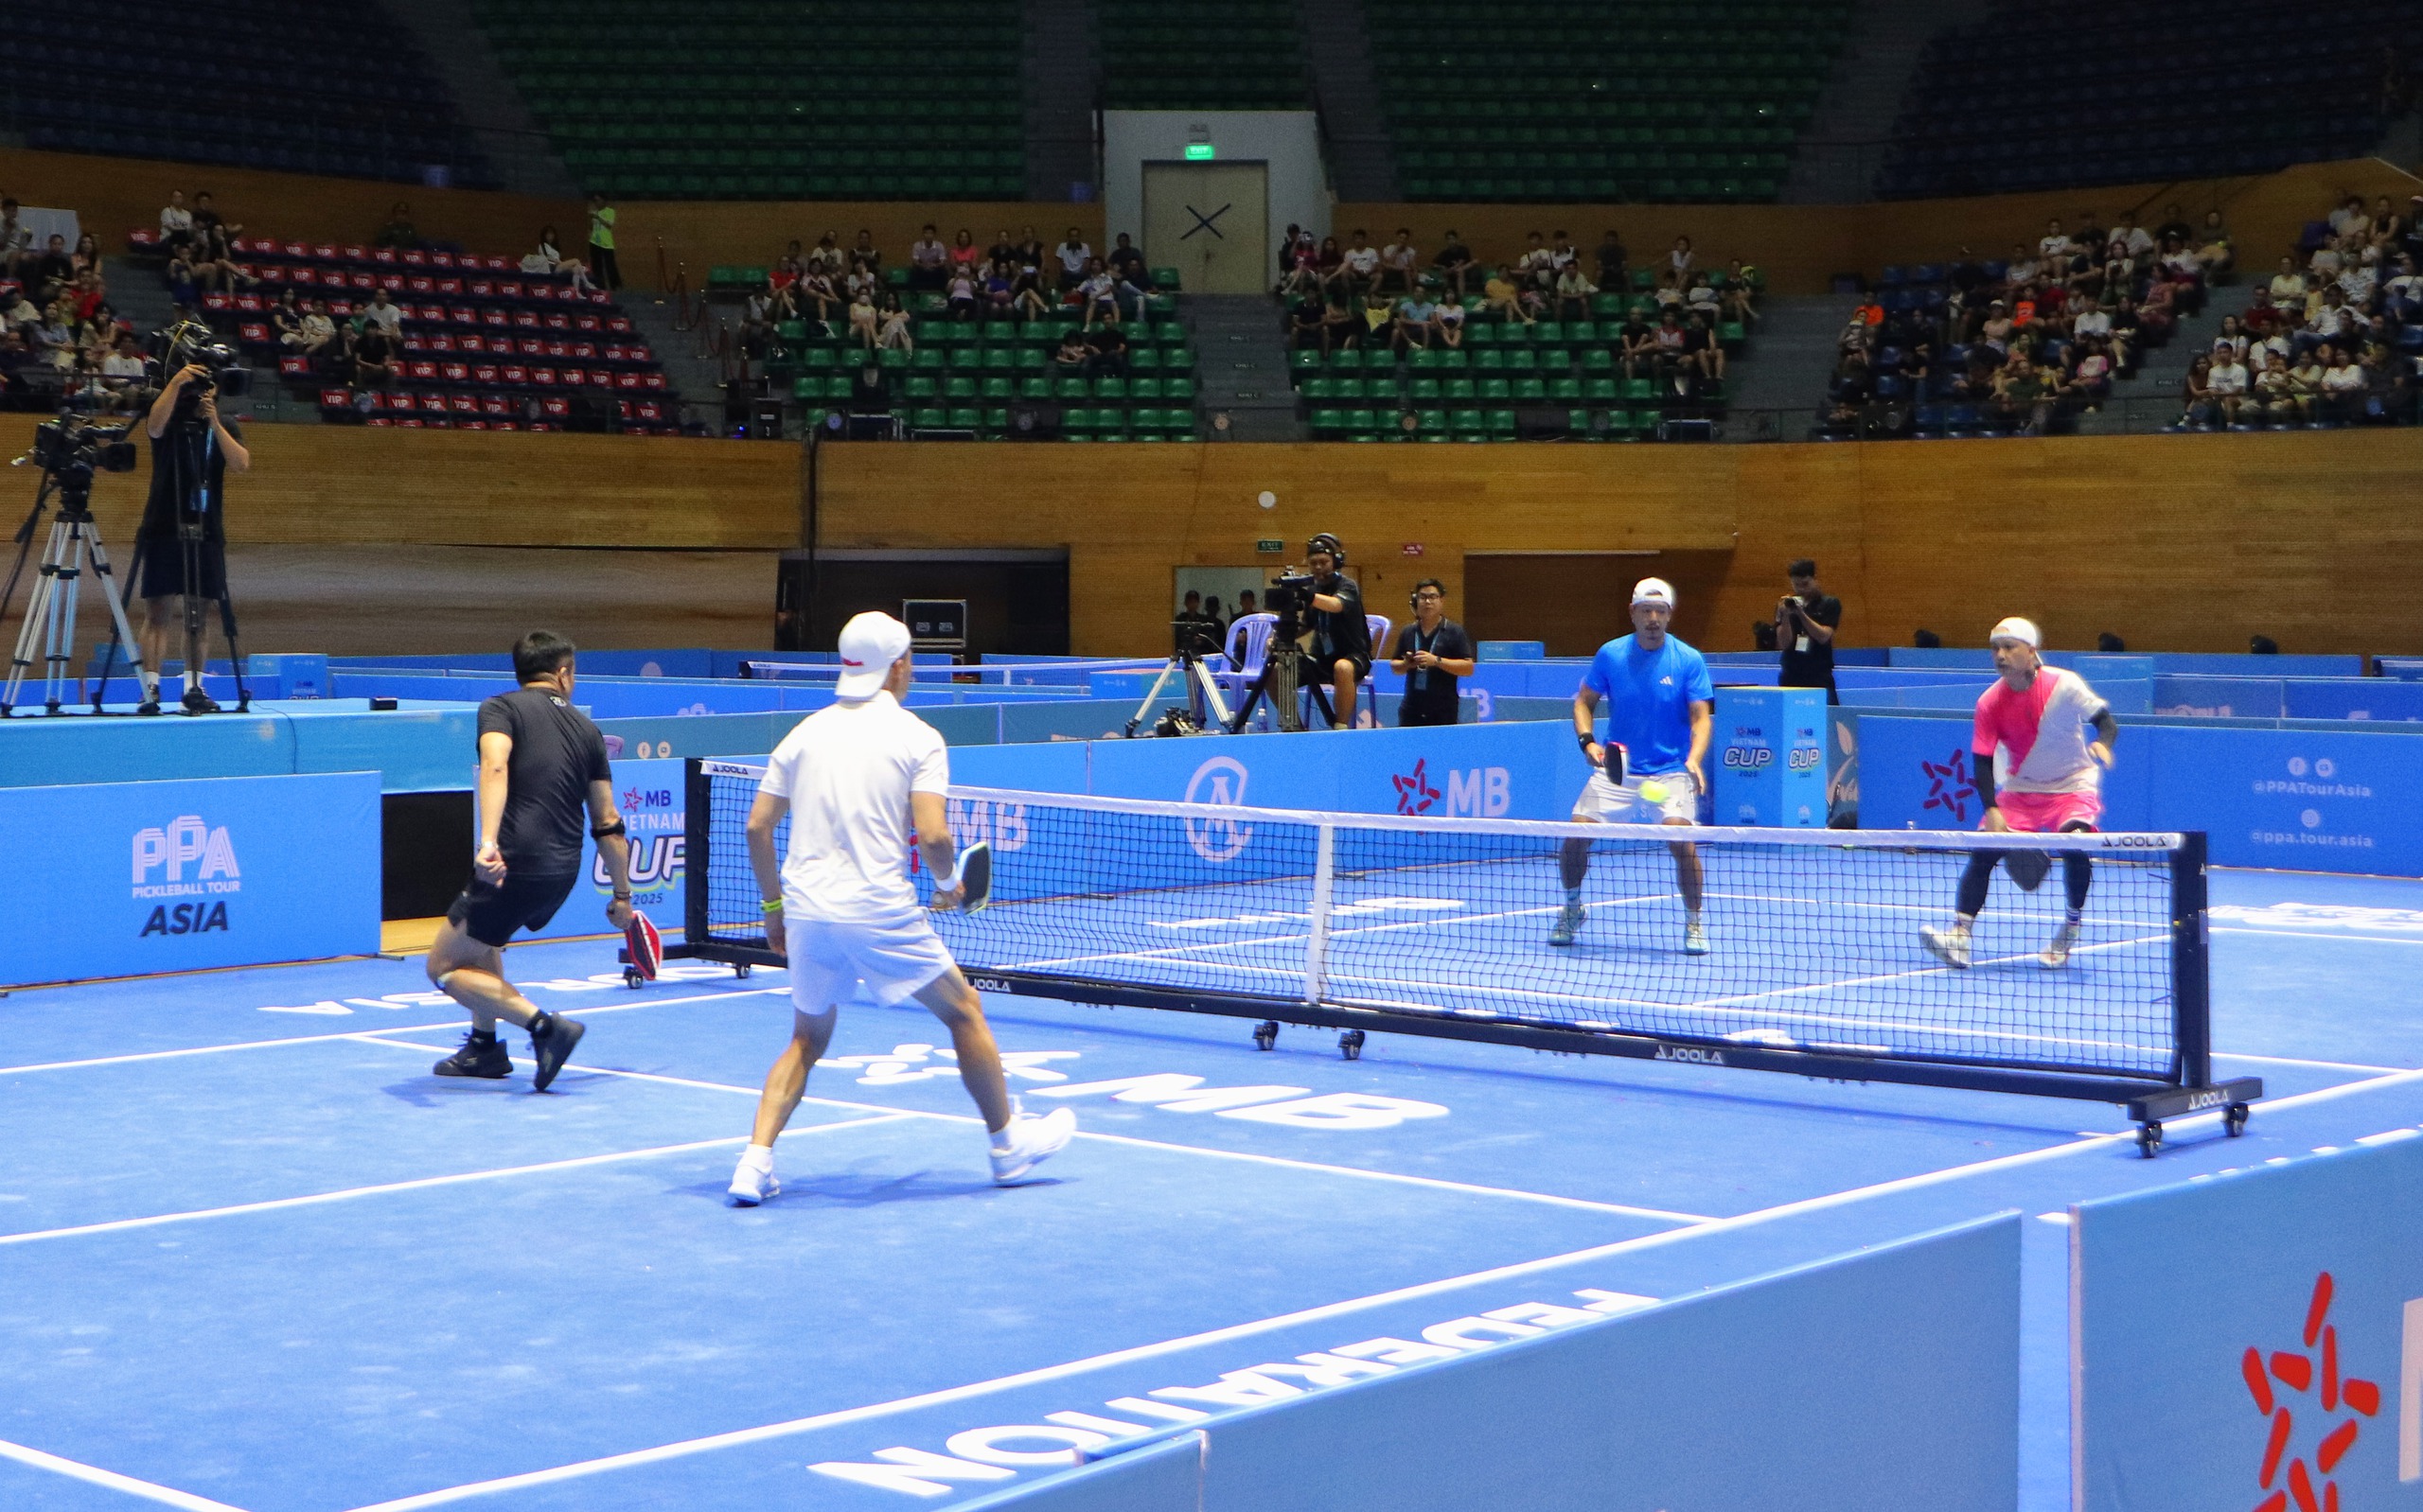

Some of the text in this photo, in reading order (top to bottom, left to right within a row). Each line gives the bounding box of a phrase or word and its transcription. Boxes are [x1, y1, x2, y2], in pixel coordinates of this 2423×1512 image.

[131, 232, 149, 241] VIP
[255, 241, 271, 251] VIP
[285, 245, 303, 255] VIP
[315, 248, 331, 256] VIP
[345, 248, 361, 256] VIP
[375, 252, 391, 260] VIP
[404, 254, 420, 262] VIP
[433, 255, 448, 264] VIP
[459, 256, 475, 266] VIP
[487, 259, 504, 268] VIP
[261, 270, 278, 279] VIP
[292, 271, 310, 280] VIP
[325, 275, 340, 285] VIP
[353, 277, 370, 286] VIP
[382, 279, 399, 288] VIP
[412, 281, 428, 290] VIP
[440, 283, 455, 291] VIP
[472, 285, 488, 294] VIP
[501, 286, 516, 294] VIP
[557, 290, 573, 299] VIP
[592, 293, 607, 303] VIP
[205, 298, 223, 308] VIP
[238, 299, 255, 308] VIP
[331, 305, 348, 314] VIP
[399, 309, 410, 319] IP
[423, 310, 438, 320] VIP
[454, 312, 470, 322] VIP
[486, 315, 503, 325] VIP
[517, 317, 533, 325] VIP
[548, 319, 564, 327] VIP
[579, 320, 594, 328] VIP
[243, 327, 259, 338] VIP
[403, 341, 419, 349] VIP
[432, 341, 448, 349] VIP
[462, 339, 478, 348] VIP
[491, 343, 507, 353] VIP
[522, 343, 539, 352] VIP
[549, 346, 564, 355] VIP
[575, 347, 591, 356] VIP
[606, 351, 622, 360] VIP
[629, 351, 645, 360] VIP
[283, 362, 299, 372] VIP
[415, 366, 431, 376] VIP
[446, 368, 462, 378] VIP
[476, 370, 493, 378] VIP
[505, 370, 522, 379] VIP
[534, 372, 550, 381] VIP
[563, 374, 579, 382] VIP
[592, 375, 608, 383] VIP
[620, 378, 635, 386] VIP
[646, 378, 661, 386] VIP
[326, 395, 343, 404] VIP
[392, 398, 408, 408] VIP
[424, 400, 440, 410] VIP
[454, 400, 470, 410] VIP
[486, 403, 503, 413] VIP
[546, 403, 563, 412] VIP
[639, 408, 655, 417] VIP
[1746, 728, 1761, 736] MB
[1731, 738, 1766, 747] VIETNAM
[1723, 747, 1773, 767] CUP
[1789, 747, 1820, 769] CUP
[1446, 766, 1511, 818] MB
[2252, 781, 2372, 797] @PPATourAsia
[646, 789, 671, 807] MB
[622, 812, 684, 831] IETNAM
[947, 799, 1029, 853] MB
[2251, 831, 2374, 848] @ppa.tour.asia
[132, 815, 241, 885] PPA
[132, 880, 241, 899] PICKLEBALL TOUR
[632, 893, 663, 905] 2025
[139, 900, 229, 938] ASIA
[1025, 1073, 1451, 1130] MB
